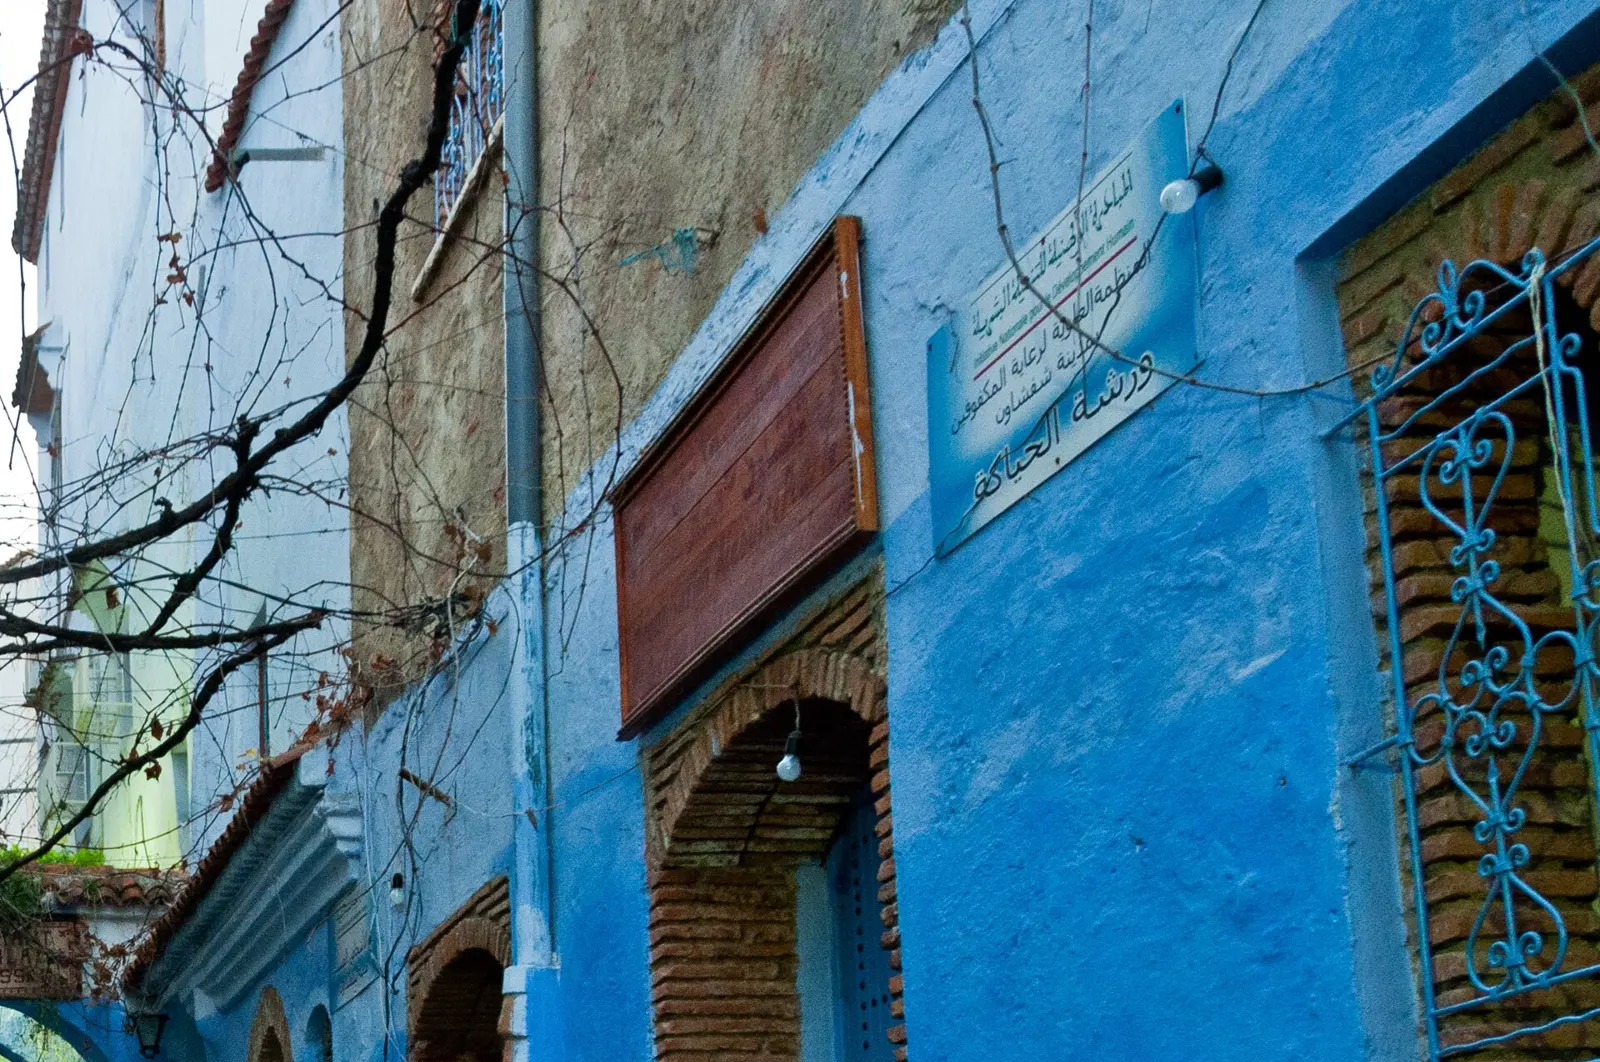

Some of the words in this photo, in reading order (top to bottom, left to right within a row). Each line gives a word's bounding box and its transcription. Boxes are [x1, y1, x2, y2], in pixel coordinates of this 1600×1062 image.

[1095, 241, 1151, 304] المنظمة
[1012, 328, 1047, 377] لرعاية
[996, 368, 1052, 425] شفشاون
[1073, 354, 1153, 422] ورشة
[975, 405, 1060, 499] الحياكة
